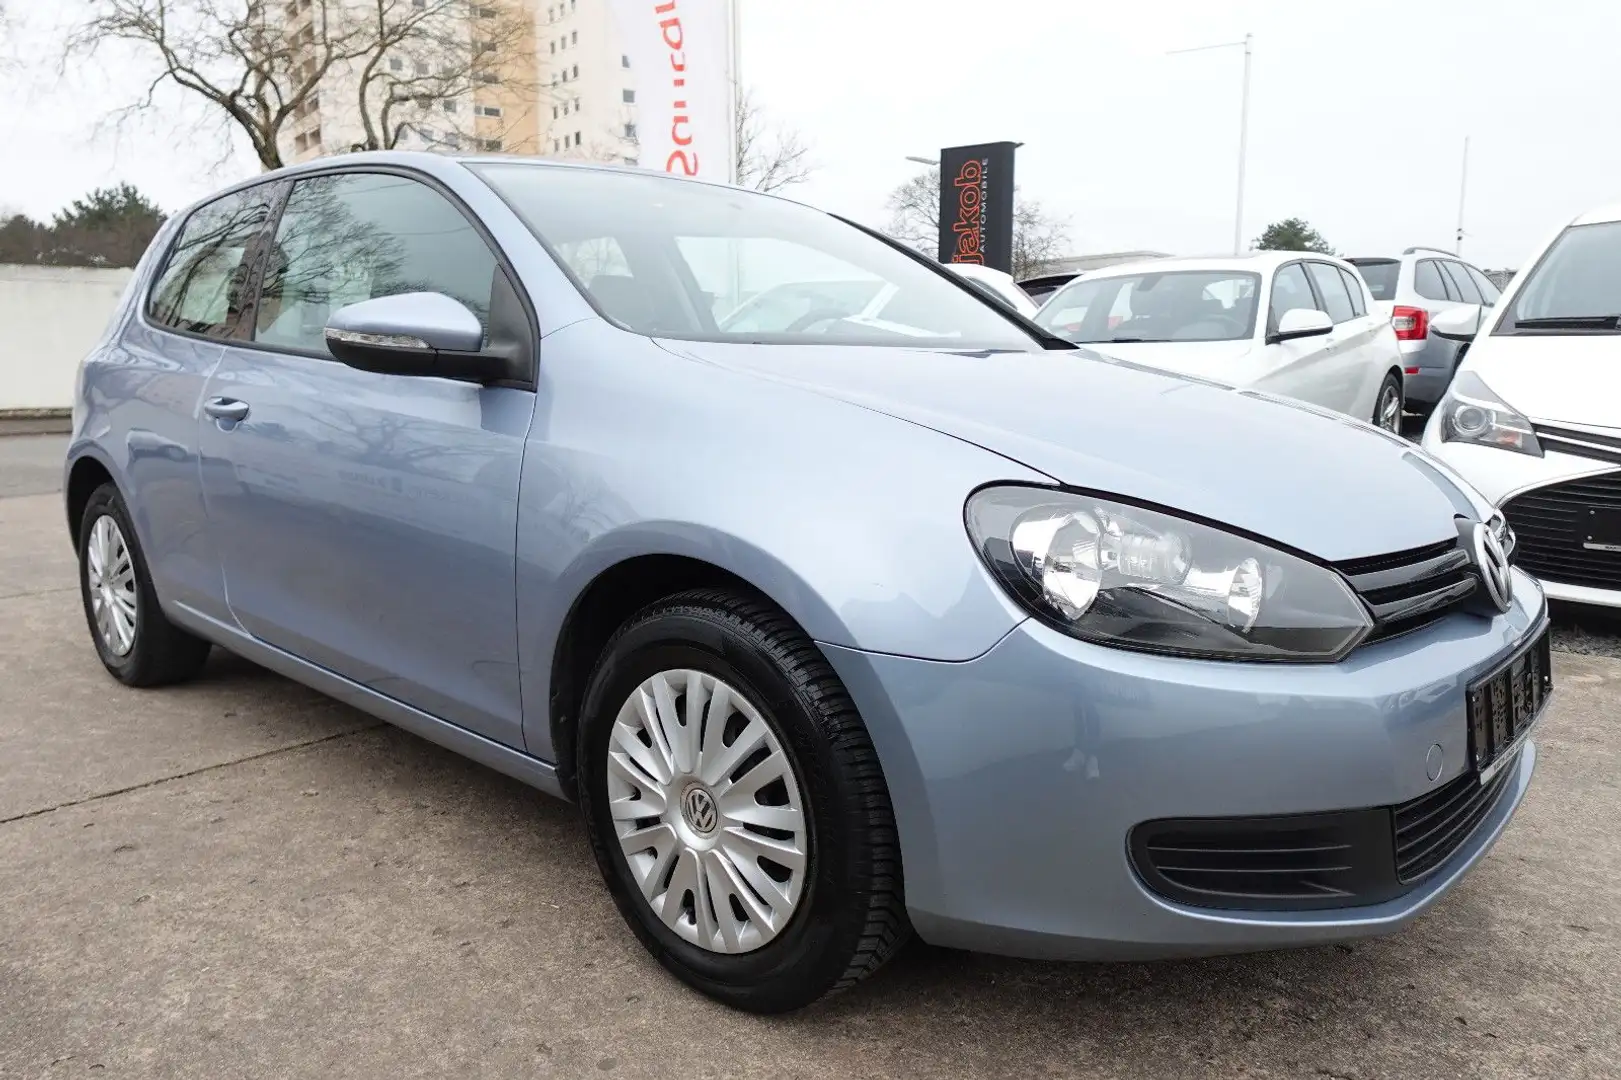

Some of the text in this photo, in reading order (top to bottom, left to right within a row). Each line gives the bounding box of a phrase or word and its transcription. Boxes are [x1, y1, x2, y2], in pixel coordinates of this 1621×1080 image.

[952, 159, 985, 265] jakob
[979, 158, 989, 253] AUTOMOBILE
[686, 789, 717, 832] VW
